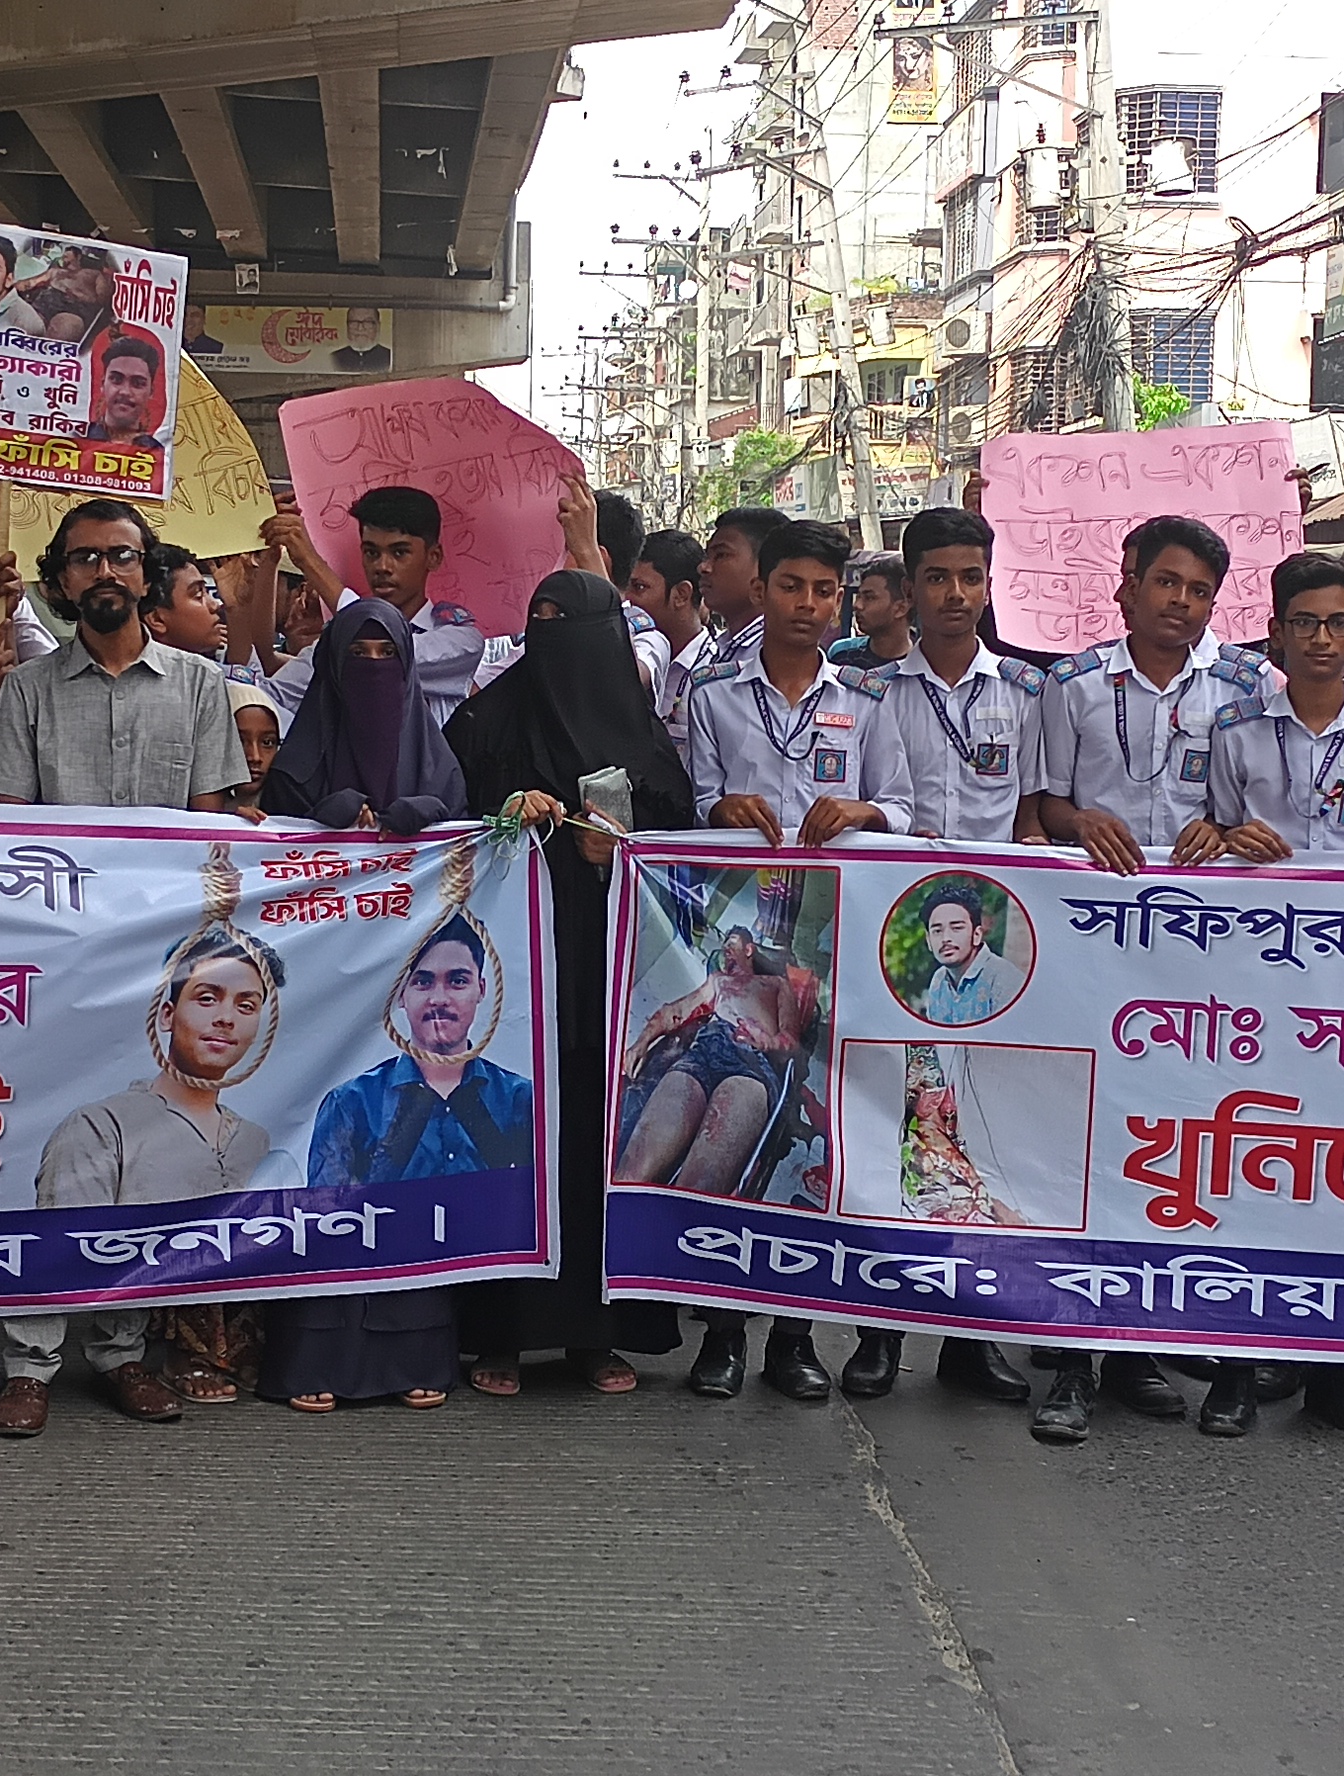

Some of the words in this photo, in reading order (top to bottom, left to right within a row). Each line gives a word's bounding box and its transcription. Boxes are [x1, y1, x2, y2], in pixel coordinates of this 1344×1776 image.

[113, 258, 152, 322] ফাঁসি
[153, 278, 176, 329] চাই
[17, 384, 30, 397] ও
[44, 383, 78, 410] খুনি
[28, 411, 88, 436] রাকিব
[94, 450, 156, 481] চাই
[260, 850, 351, 880] ফাঁসি
[259, 886, 348, 924] ফাঁসি
[354, 882, 414, 919] চাই
[1110, 995, 1263, 1065] মোঃ
[64, 1201, 396, 1268] জনগণ
[676, 1223, 999, 1300] প্রচারে:
